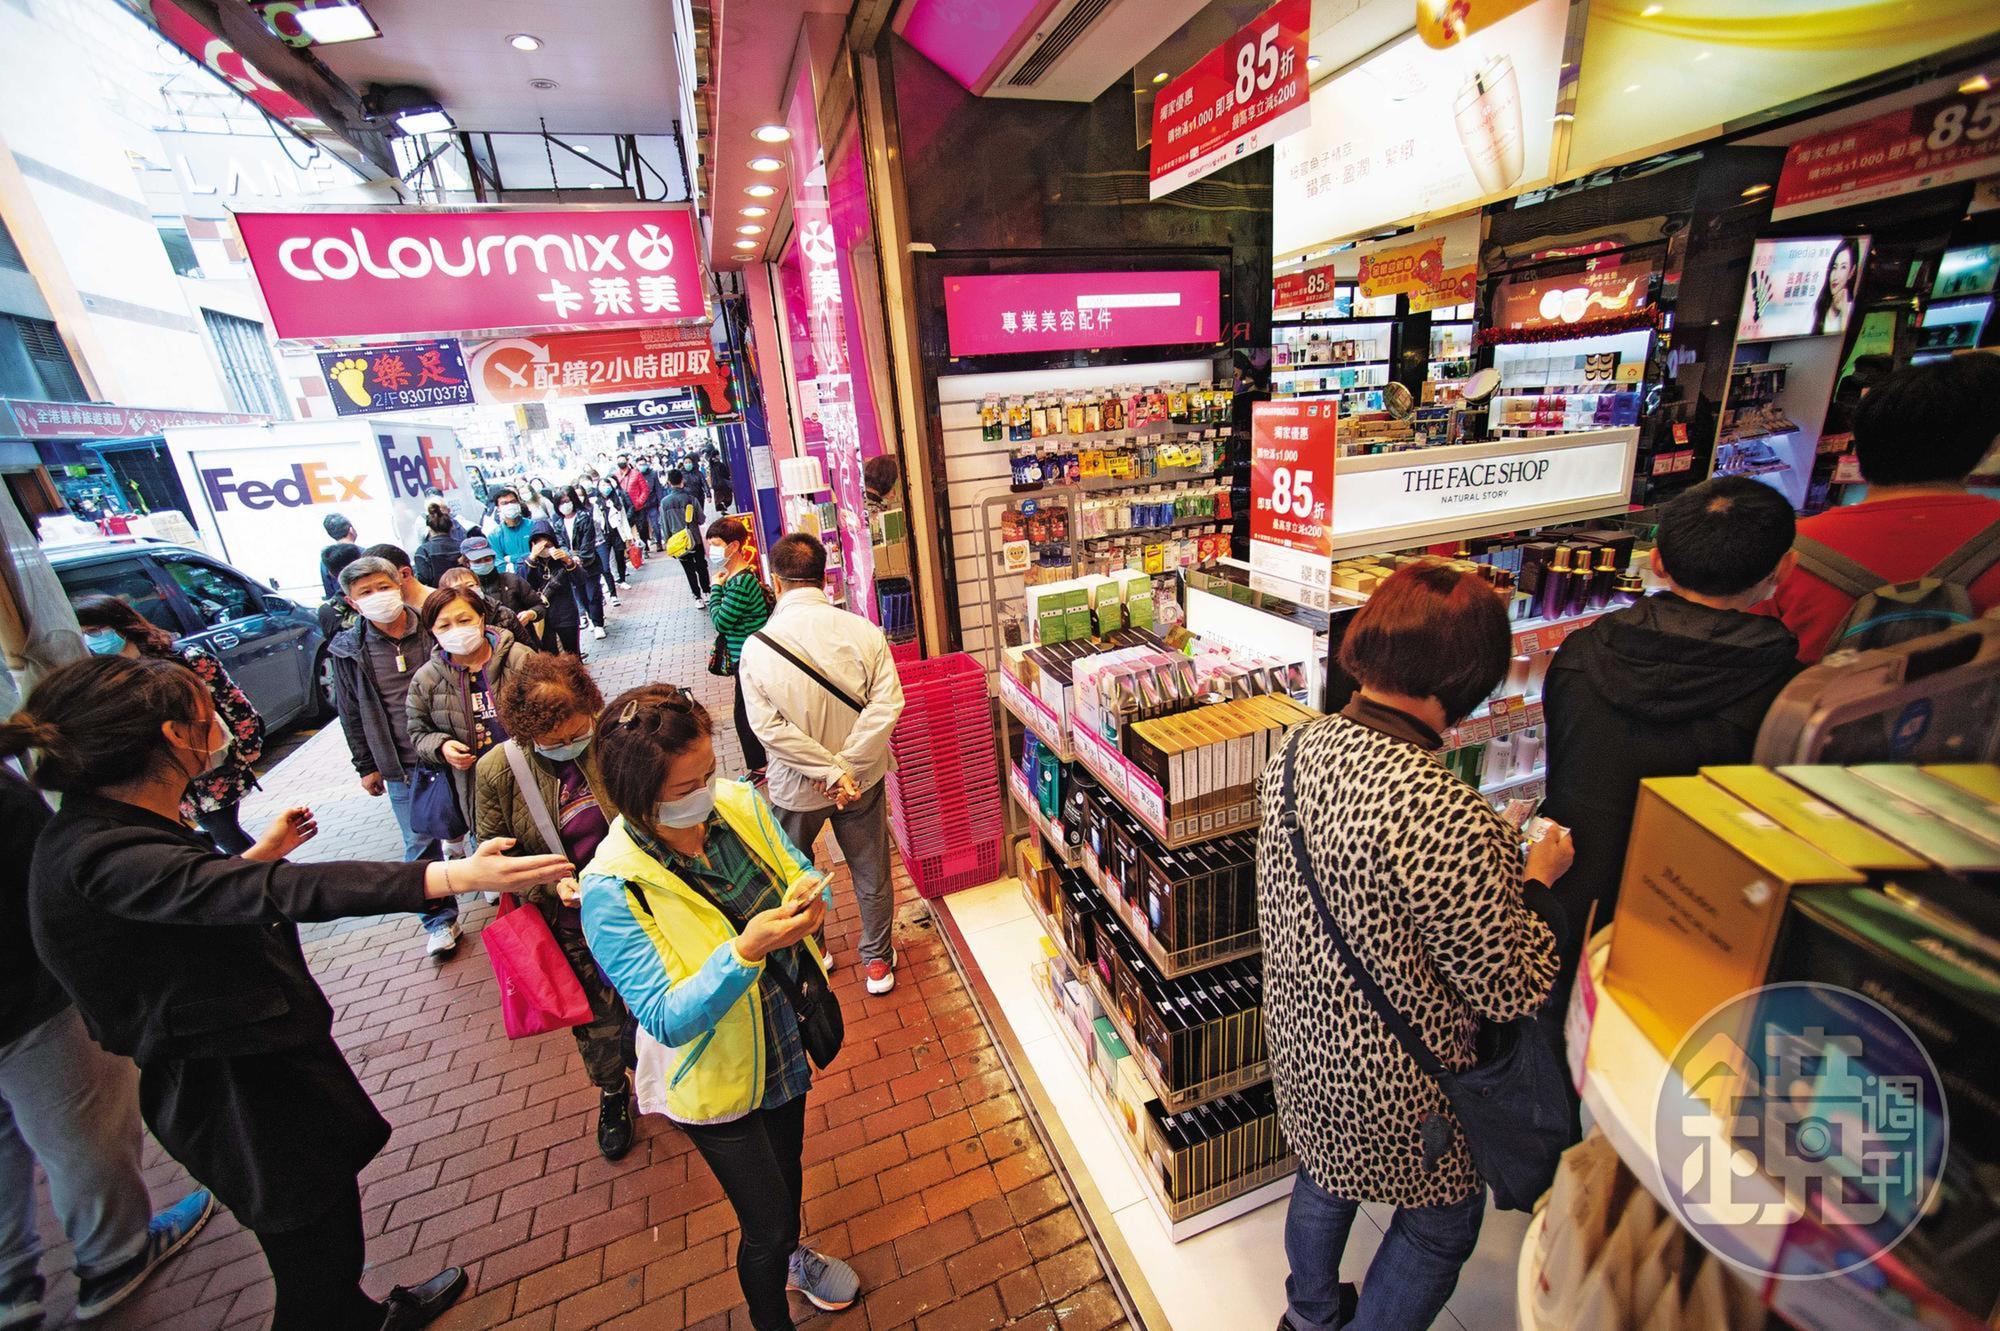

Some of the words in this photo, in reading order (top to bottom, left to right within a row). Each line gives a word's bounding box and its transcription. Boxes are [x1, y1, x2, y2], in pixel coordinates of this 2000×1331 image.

[537, 273, 681, 320] 卡萊美
[1001, 307, 1113, 335] 專業美容配件
[533, 349, 711, 390] 配鏡2小時即取
[398, 384, 468, 404] 93070379
[377, 434, 459, 499] FedEx
[1403, 468, 1445, 493] THE
[1446, 463, 1497, 489] FACE
[1497, 459, 1550, 484] SHOP
[201, 461, 374, 512] FedEx
[1441, 491, 1480, 504] NATURAL
[1482, 489, 1509, 500] STORY
